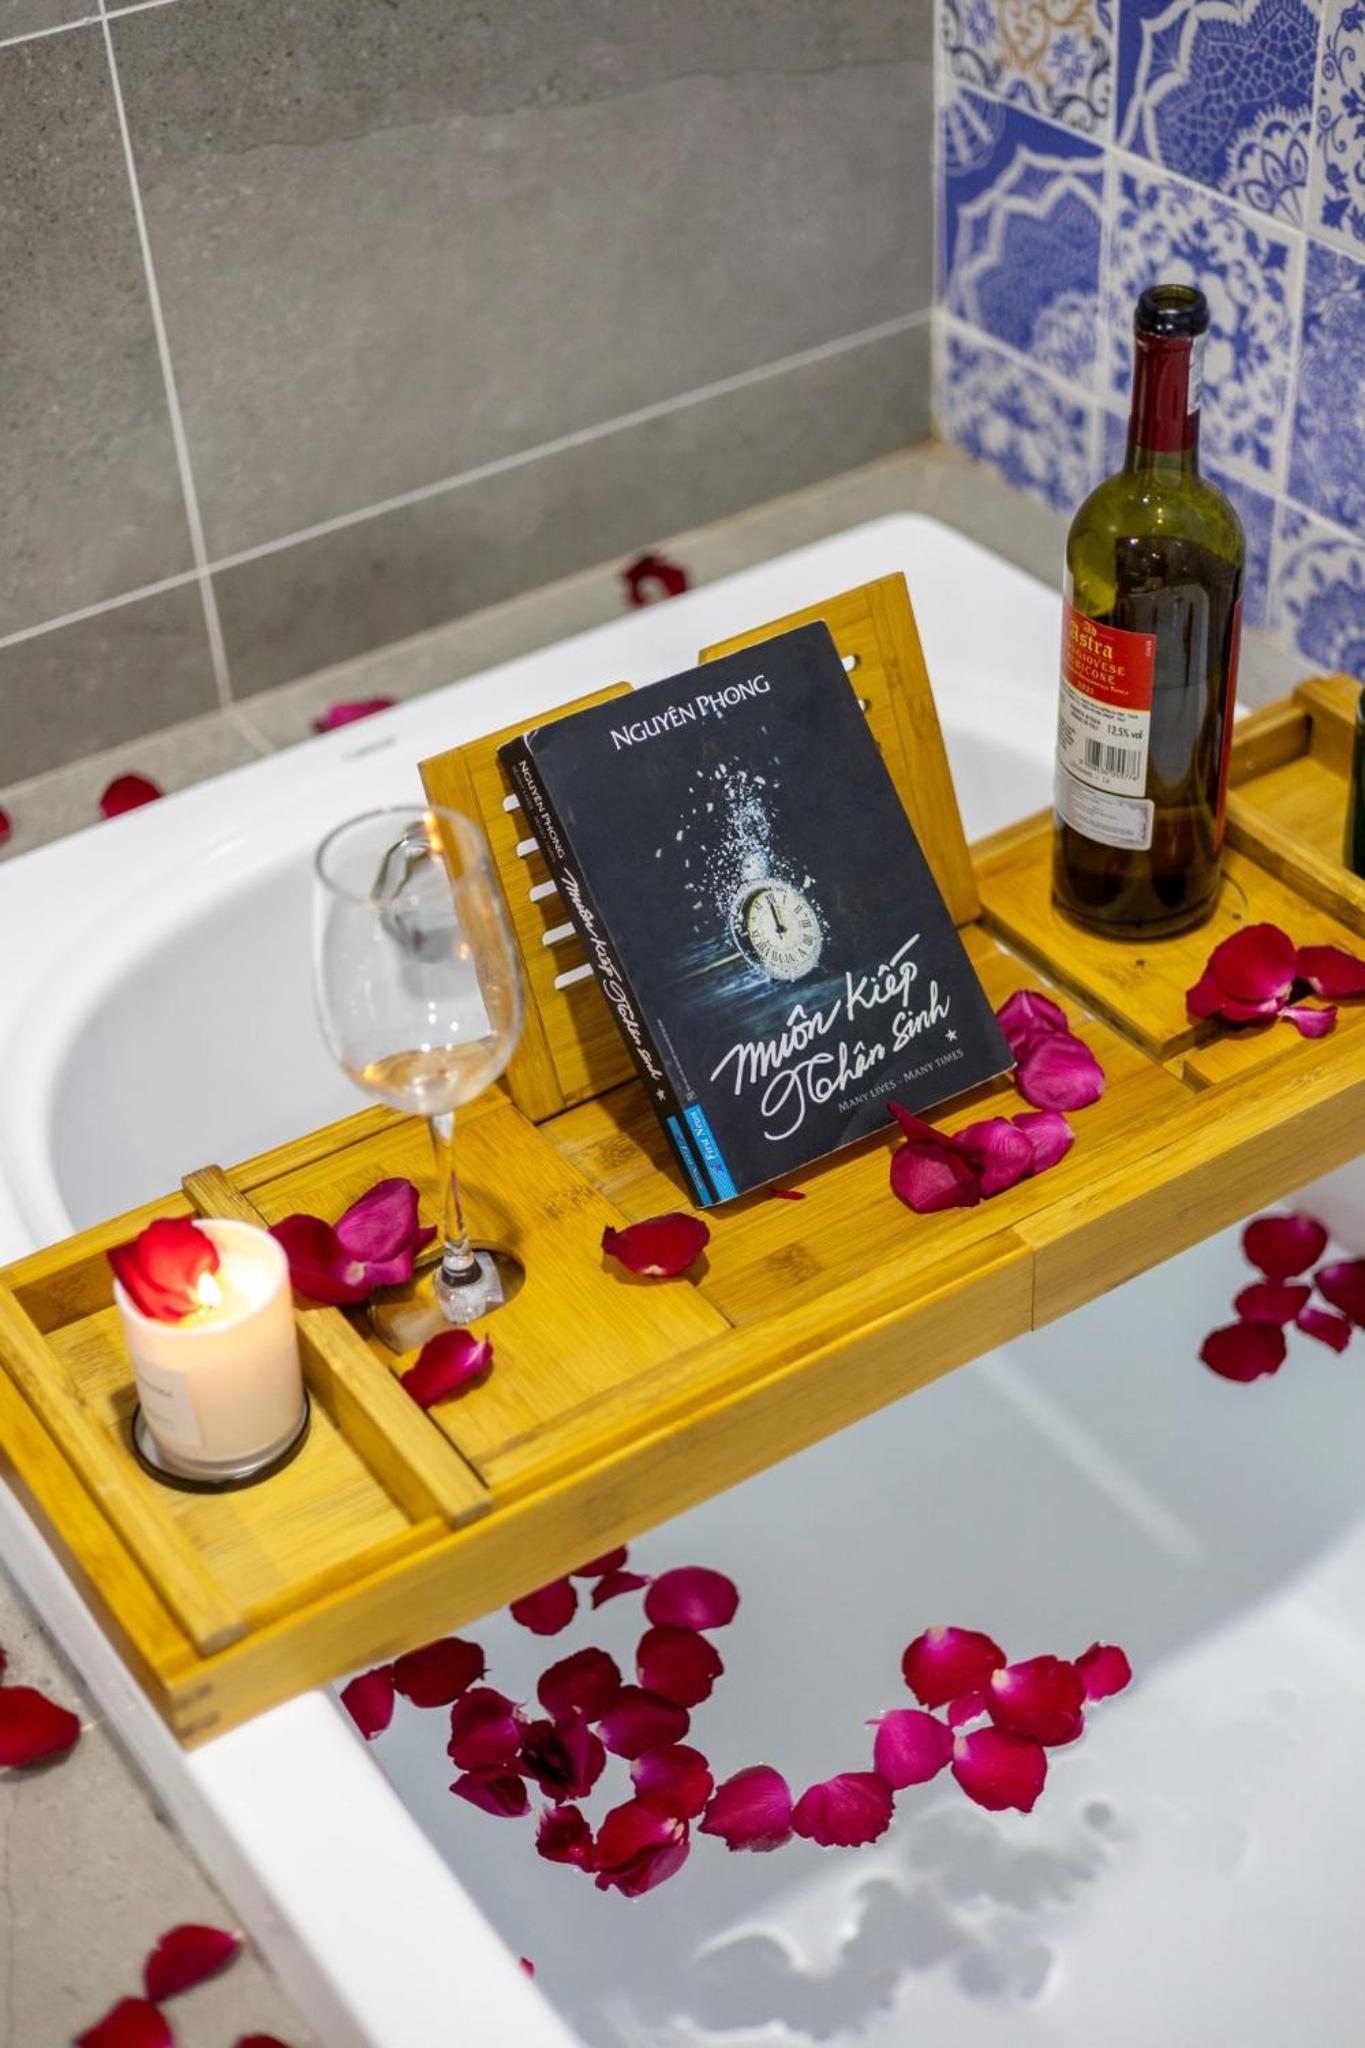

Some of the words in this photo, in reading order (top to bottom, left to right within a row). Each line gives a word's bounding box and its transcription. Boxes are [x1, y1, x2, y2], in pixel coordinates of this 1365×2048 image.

[1071, 620, 1113, 660] Astra
[609, 703, 697, 750] NGUYÊN
[695, 674, 771, 718] PHONG
[541, 813, 565, 859] PHONG
[710, 999, 841, 1096] Muôn
[845, 933, 920, 1021] Kiếp
[892, 980, 950, 1052] Sinh
[838, 1093, 868, 1113] MANY
[870, 1080, 896, 1098] LIVES
[903, 1061, 934, 1082] MANY
[935, 1048, 964, 1069] TIMES
